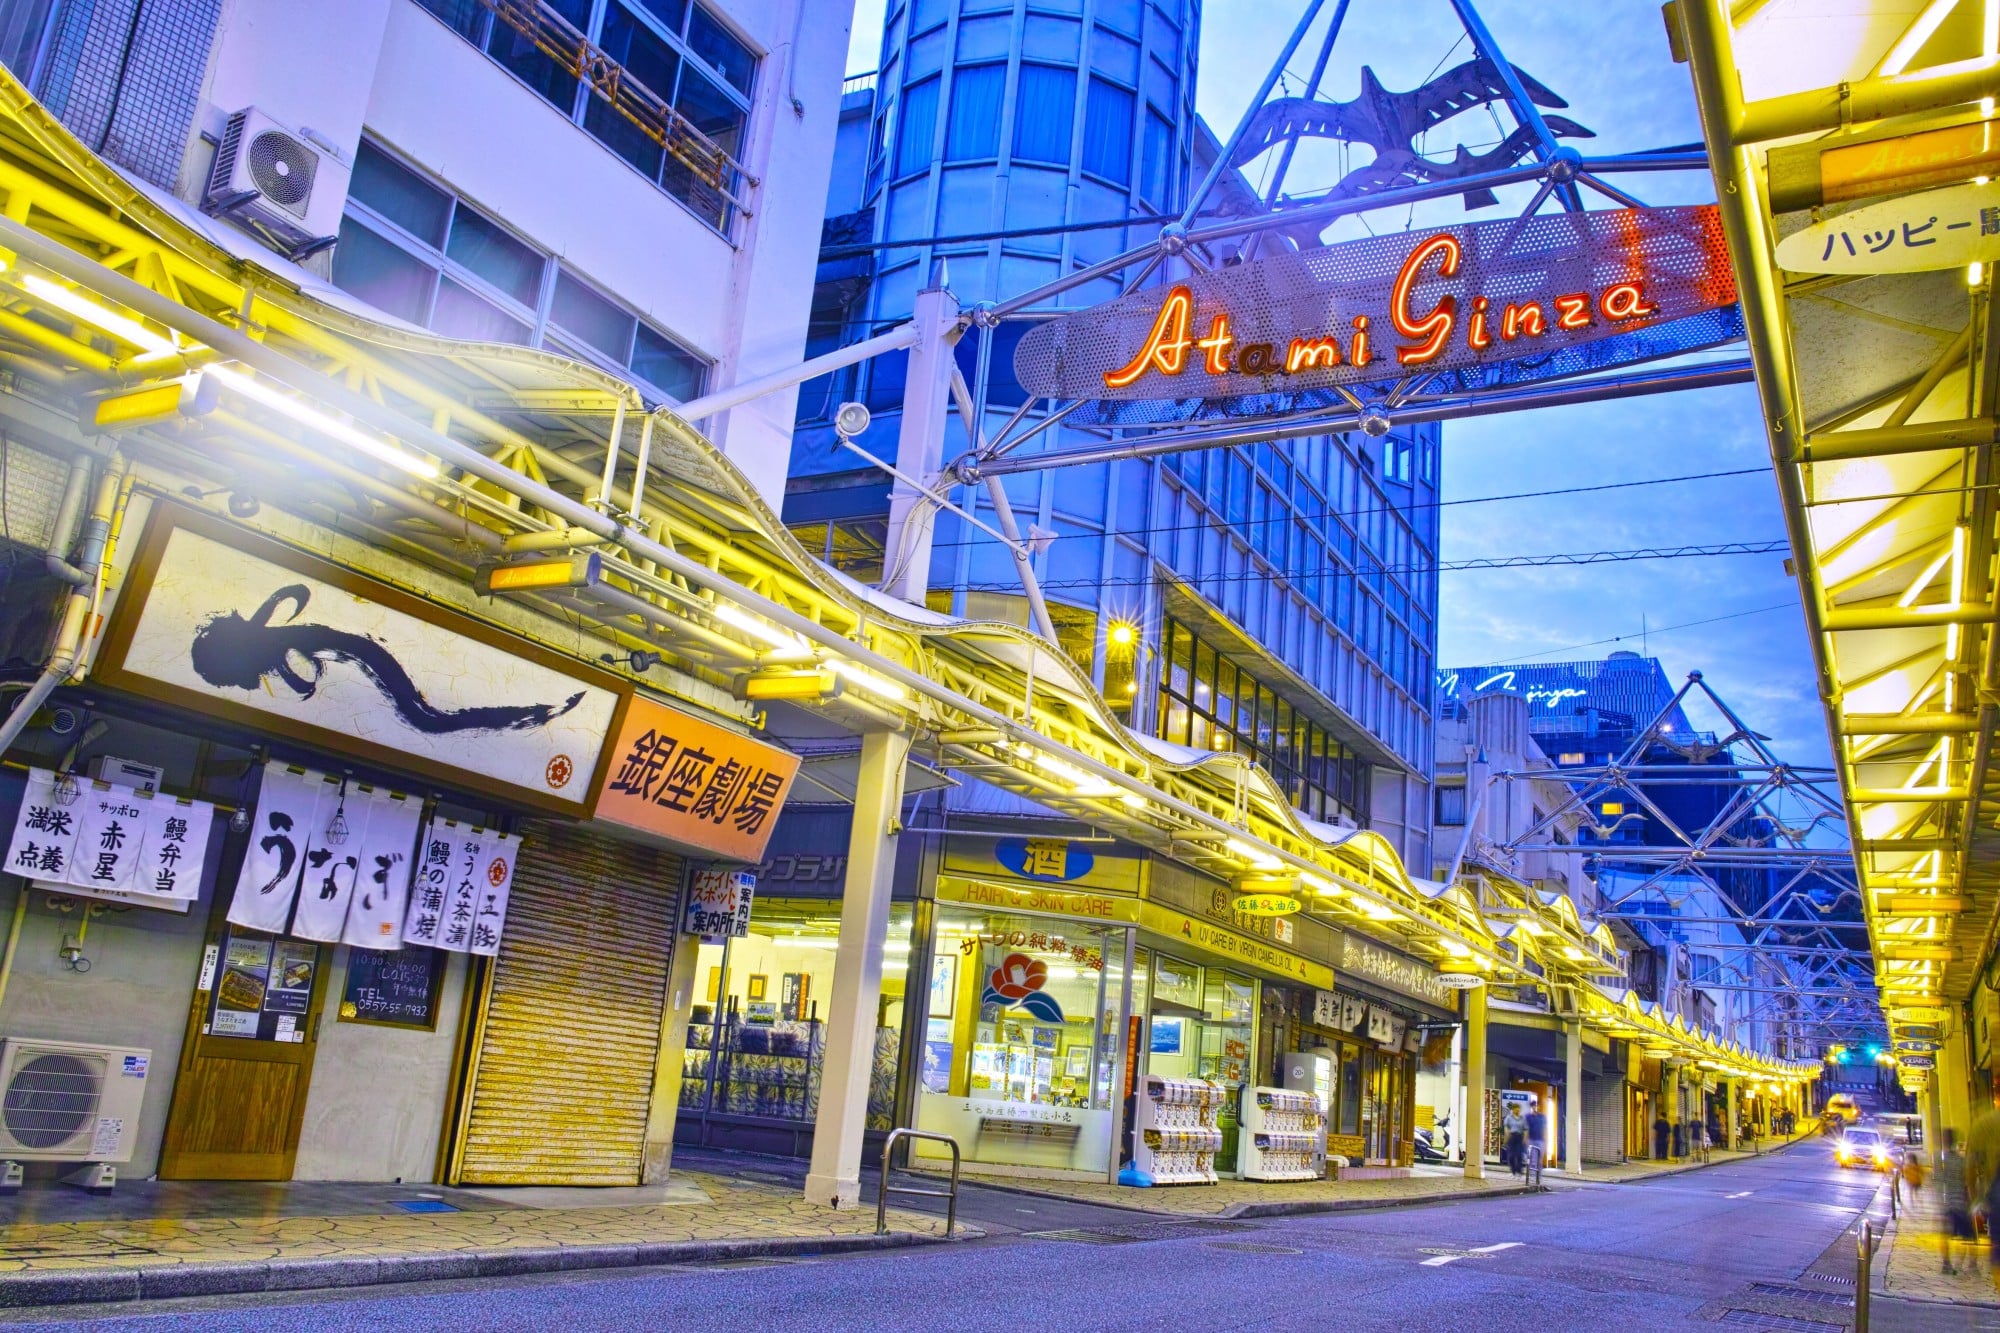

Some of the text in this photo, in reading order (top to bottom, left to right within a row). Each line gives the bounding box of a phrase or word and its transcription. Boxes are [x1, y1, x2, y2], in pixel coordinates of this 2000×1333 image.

[1852, 140, 1962, 178] Atami
[1103, 232, 1660, 389] Atami Ginza
[609, 728, 785, 835] 銀座劇場
[99, 801, 140, 819] サッポロ
[91, 820, 126, 882] 赤星
[155, 816, 188, 892] 鰻弁当
[259, 811, 404, 911] うなぎ
[1022, 837, 1069, 878] 酒
[412, 839, 450, 940] 鰻の蒲焼
[445, 855, 474, 946] うな茶漬
[693, 886, 736, 905] スポット
[704, 871, 734, 888] ナイト
[967, 884, 1004, 903] HAIR
[1029, 895, 1065, 911] SKIN
[1071, 899, 1114, 917] CARE
[692, 910, 735, 934] 案内所
[736, 887, 752, 936] 案内所
[356, 988, 385, 1000] TEL
